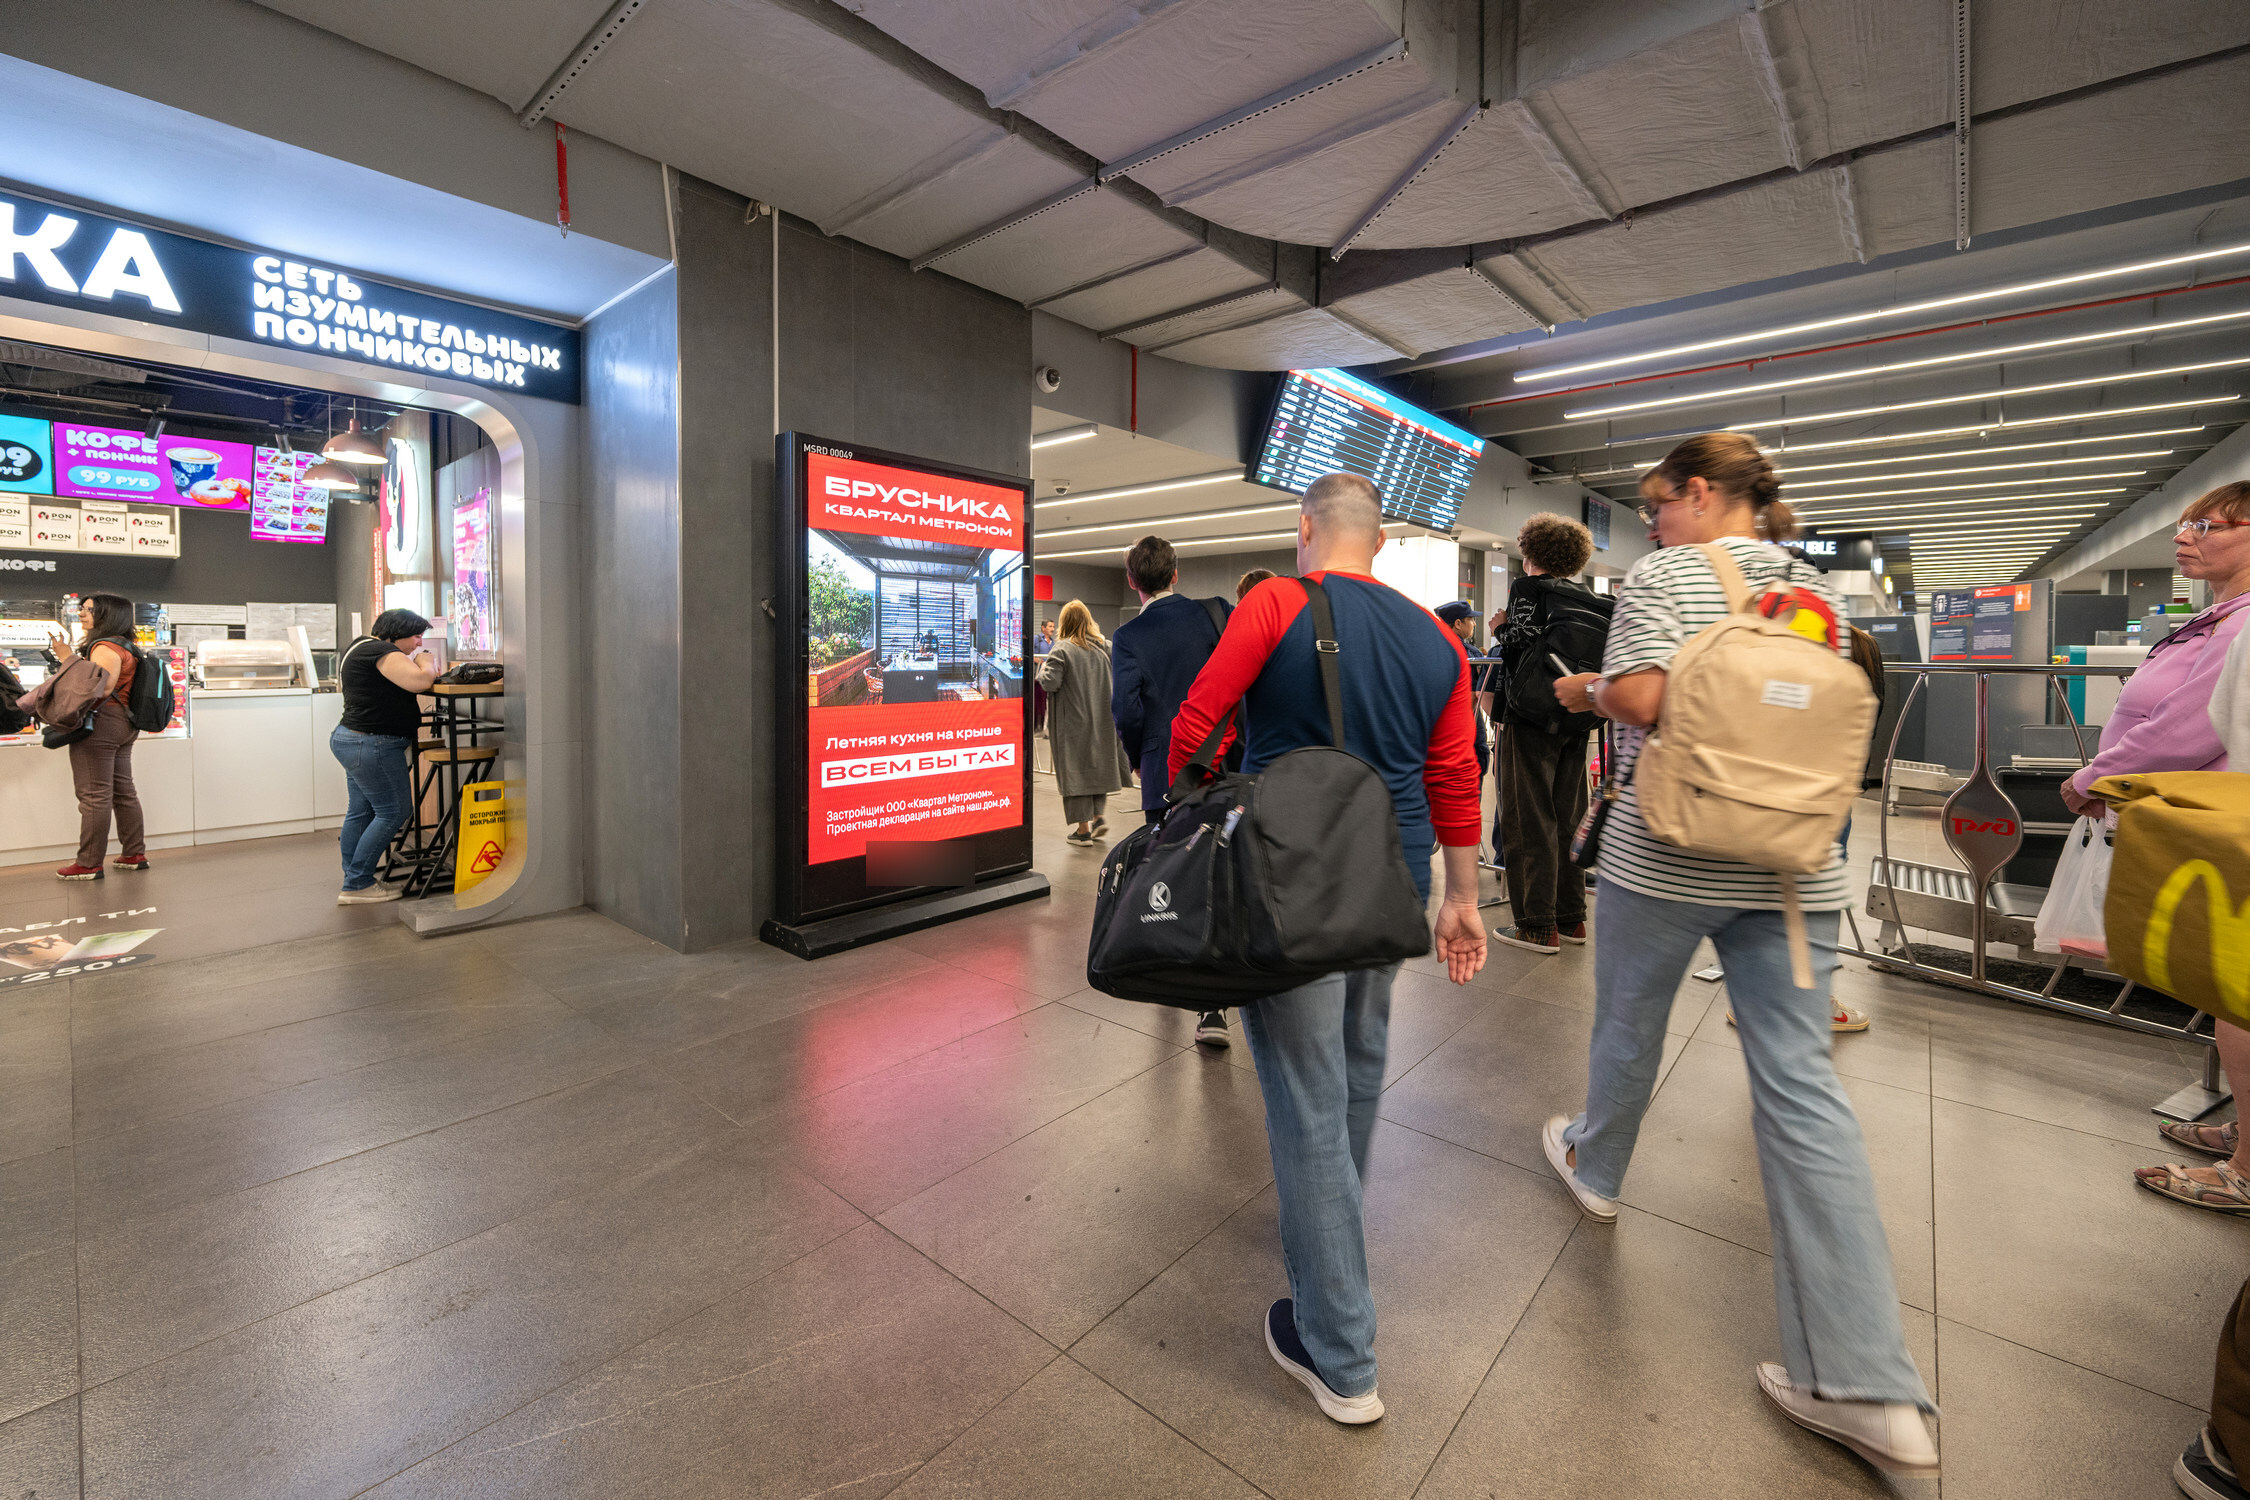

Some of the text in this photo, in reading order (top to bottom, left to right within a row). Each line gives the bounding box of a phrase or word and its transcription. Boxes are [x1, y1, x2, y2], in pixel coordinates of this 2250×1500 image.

[0, 202, 182, 315] КА
[252, 255, 363, 301] СЕТЬ
[252, 281, 562, 371] ИЗУМИТЕЛЬНЫХ
[252, 311, 526, 388] ПОНЧИКОВЫХ
[66, 429, 159, 454] КОФЕ
[803, 443, 853, 460] MSRD 00049
[0, 446, 32, 468] 9
[85, 449, 159, 465] ПОНЧИК
[0, 466, 24, 477] УБ
[79, 469, 151, 487] 99 РУБ
[825, 475, 1012, 522] БРУСНИКА
[825, 503, 1013, 537] КВАРТАЛ МЕТРОНОМ
[0, 559, 57, 572] КОФЕ
[825, 726, 1002, 750] Летняя кухня на крыше
[826, 748, 1010, 782] ВСЕМ БЫ ТАК
[469, 809, 506, 820] ОСТОРОЖН
[826, 789, 995, 823] Застройщик ООО «Квартал Метроном».
[826, 797, 1012, 837] Проектная декларация на сайте наш.дом.рф.
[469, 816, 497, 826] МОКРЫЙ
[20, 961, 114, 984] 250
